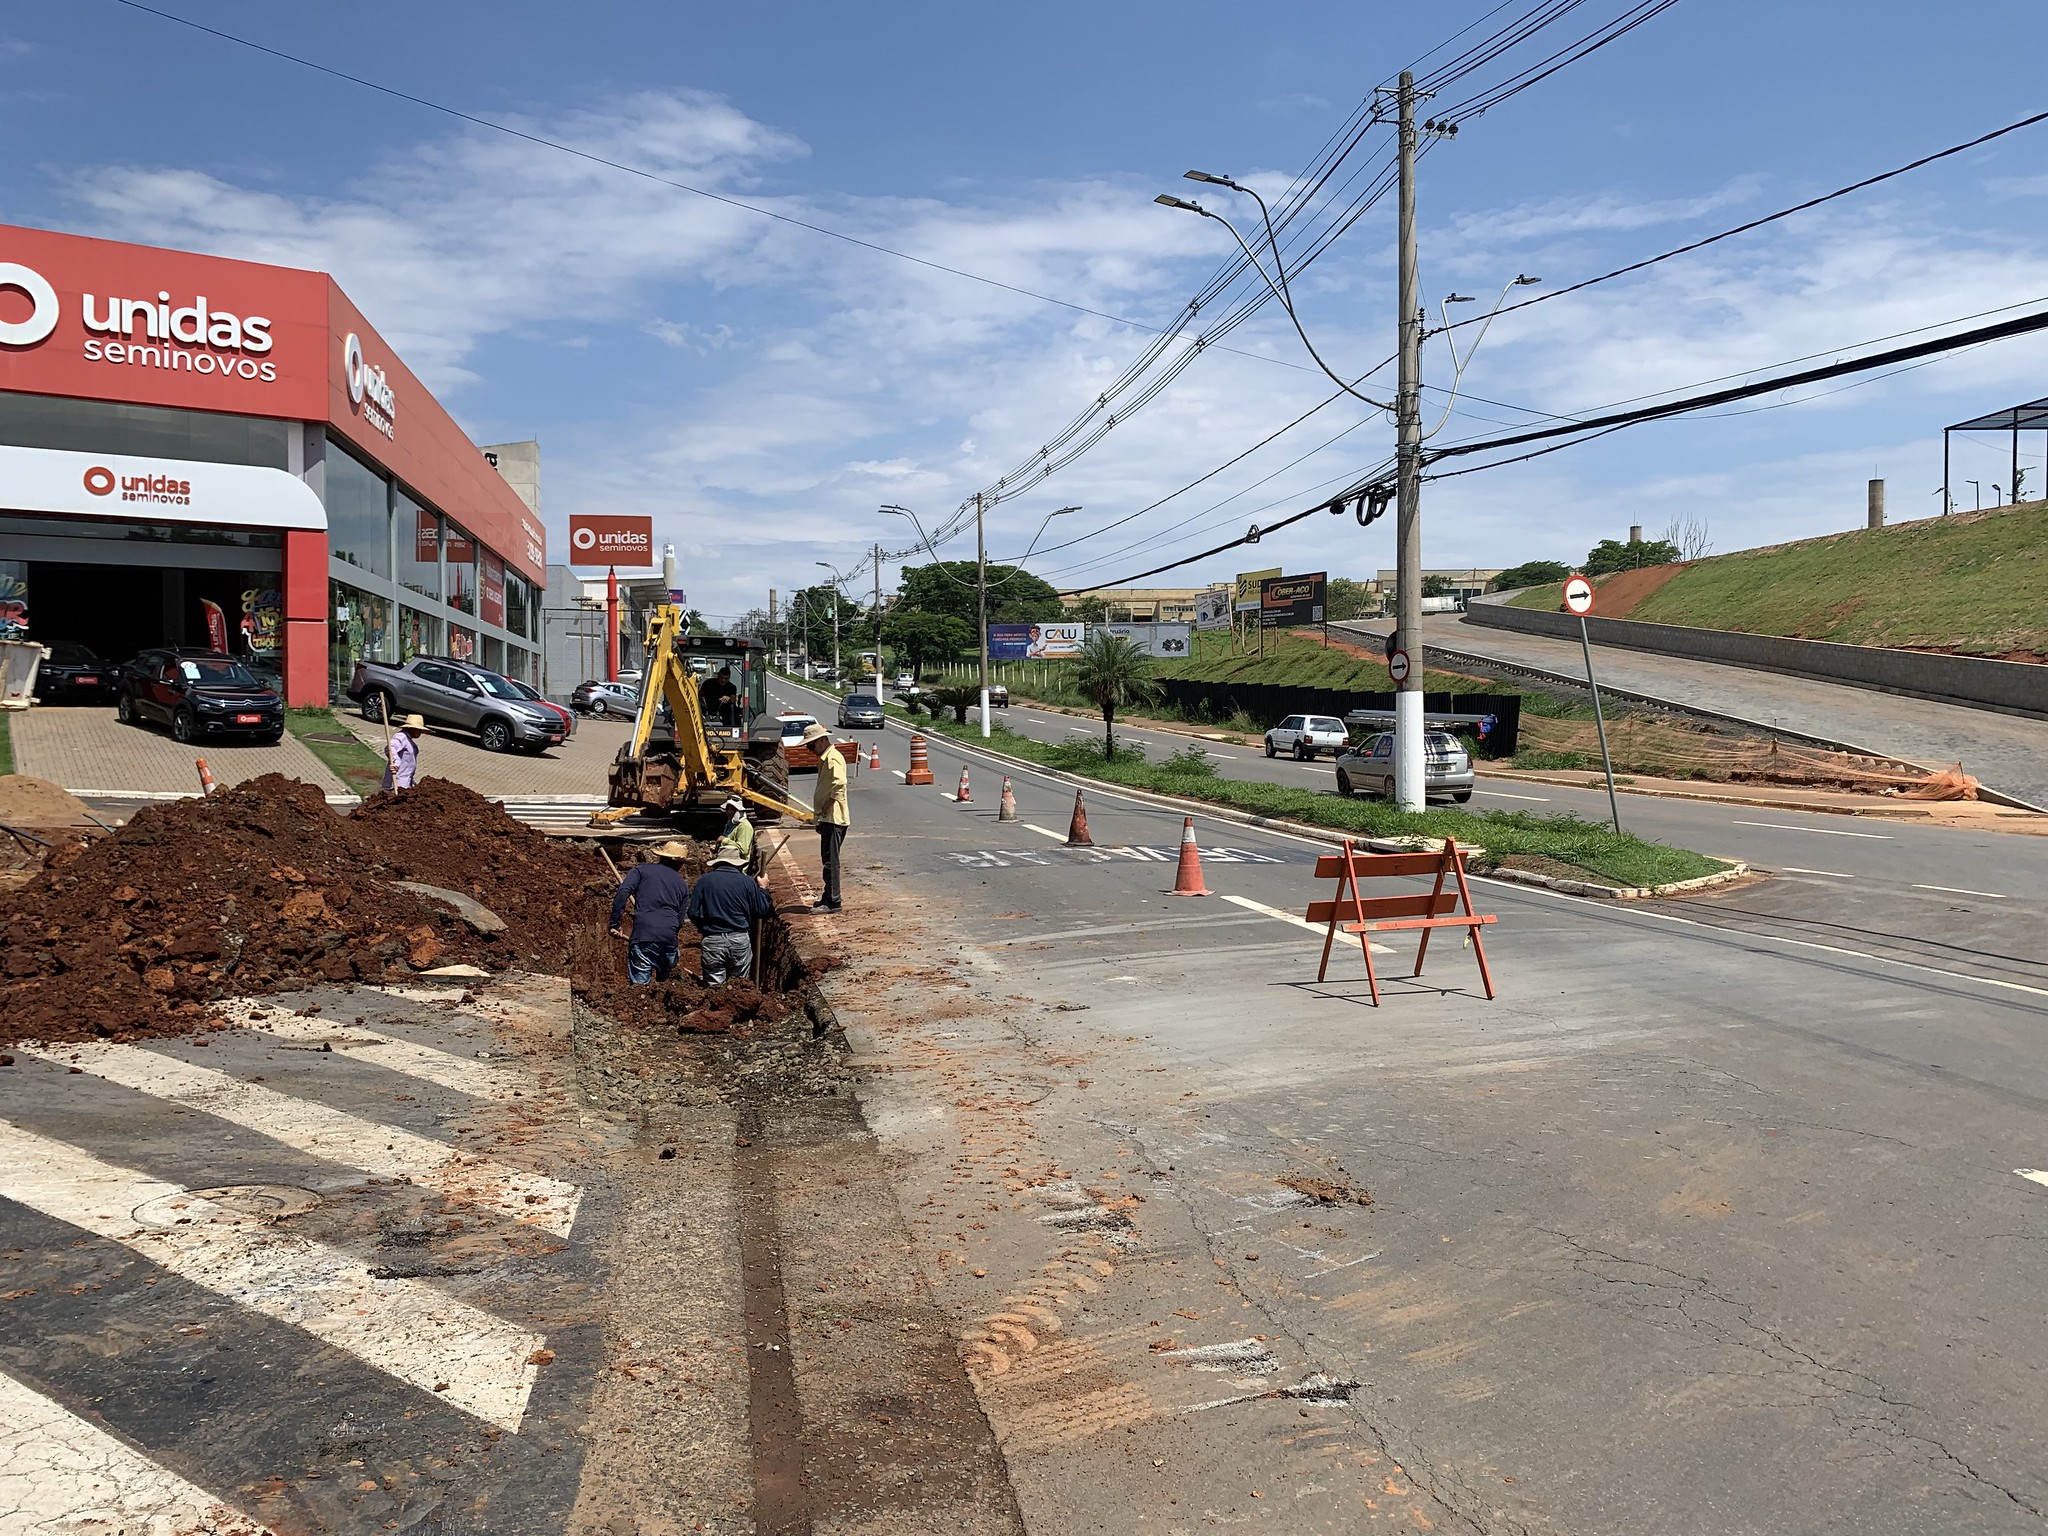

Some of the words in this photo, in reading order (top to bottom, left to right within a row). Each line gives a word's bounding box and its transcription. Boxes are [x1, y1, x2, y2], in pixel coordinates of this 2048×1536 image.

[83, 291, 273, 352] unidas
[83, 340, 277, 382] seminovos
[363, 363, 395, 420] unidas
[121, 473, 191, 495] unidas
[121, 491, 190, 505] seminovos
[599, 530, 648, 544] unidas
[599, 543, 648, 552] seminovos
[1045, 628, 1077, 639] CALU
